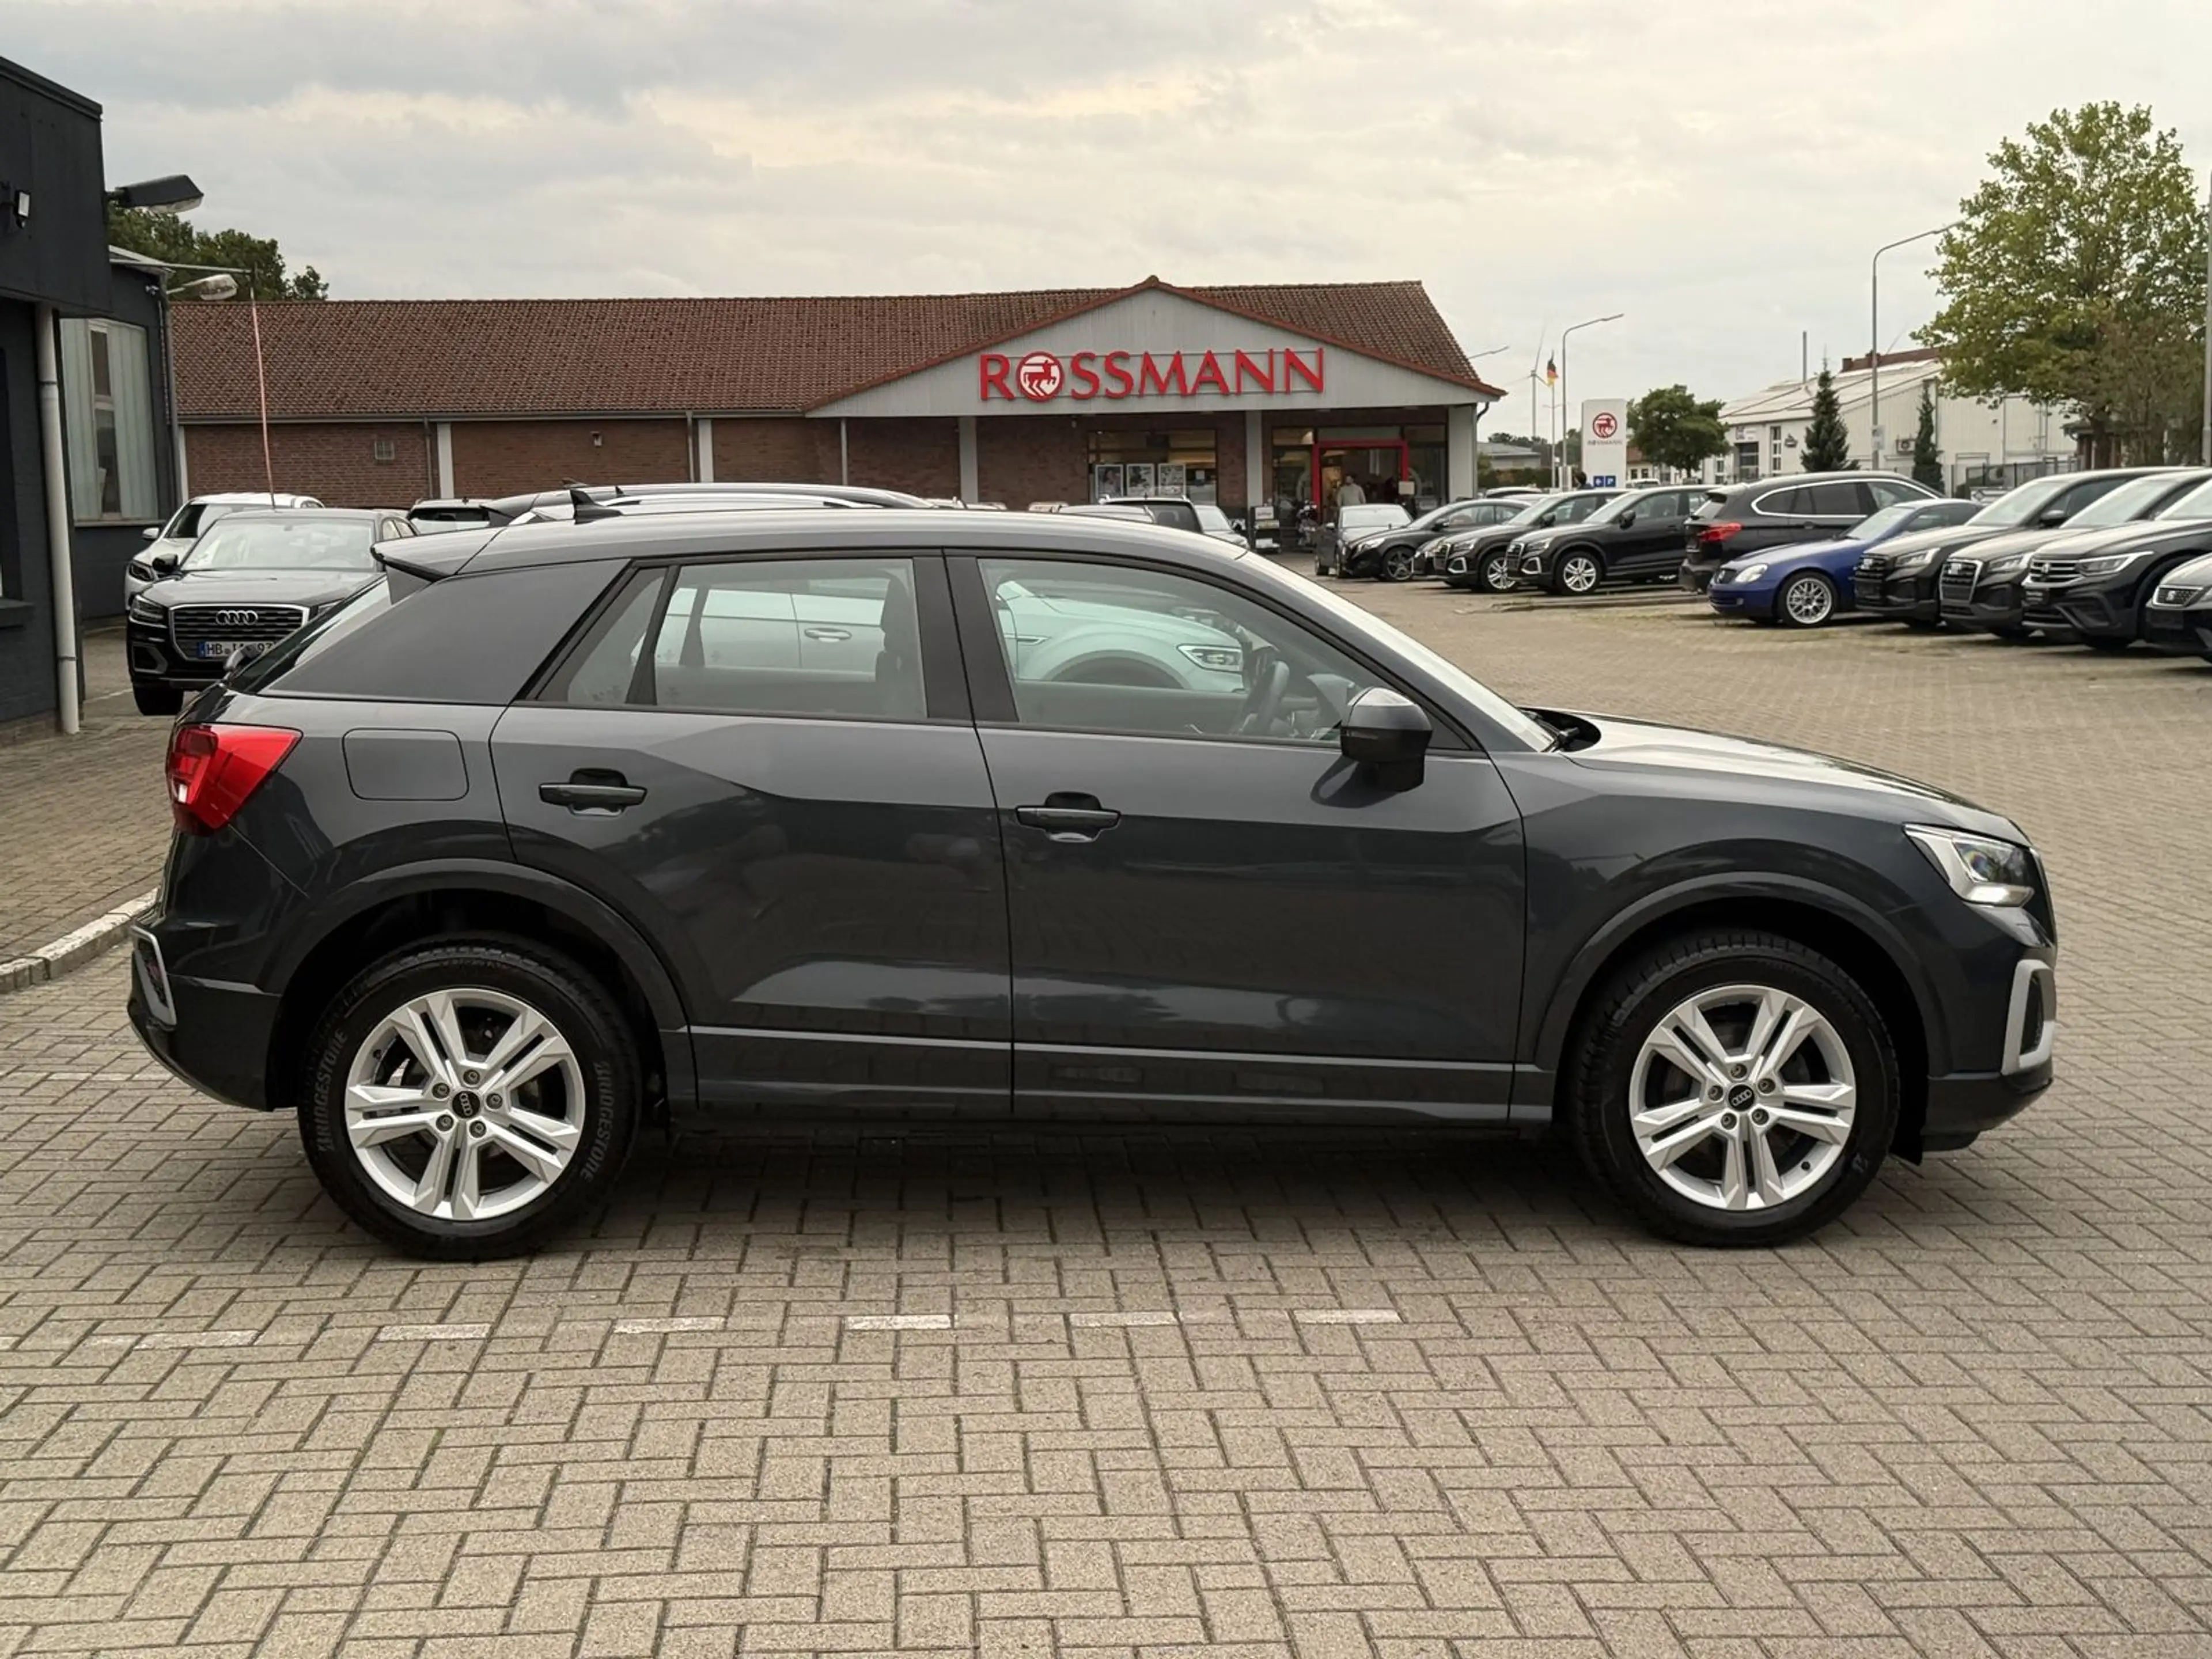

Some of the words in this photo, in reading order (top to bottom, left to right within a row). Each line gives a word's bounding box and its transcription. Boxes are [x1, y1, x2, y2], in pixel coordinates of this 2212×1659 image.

[980, 347, 1324, 402] ROSSMANN
[207, 643, 223, 655] HB
[313, 1028, 349, 1153] BRIDGESTONE
[579, 1060, 615, 1183] BRIDGESTONE
